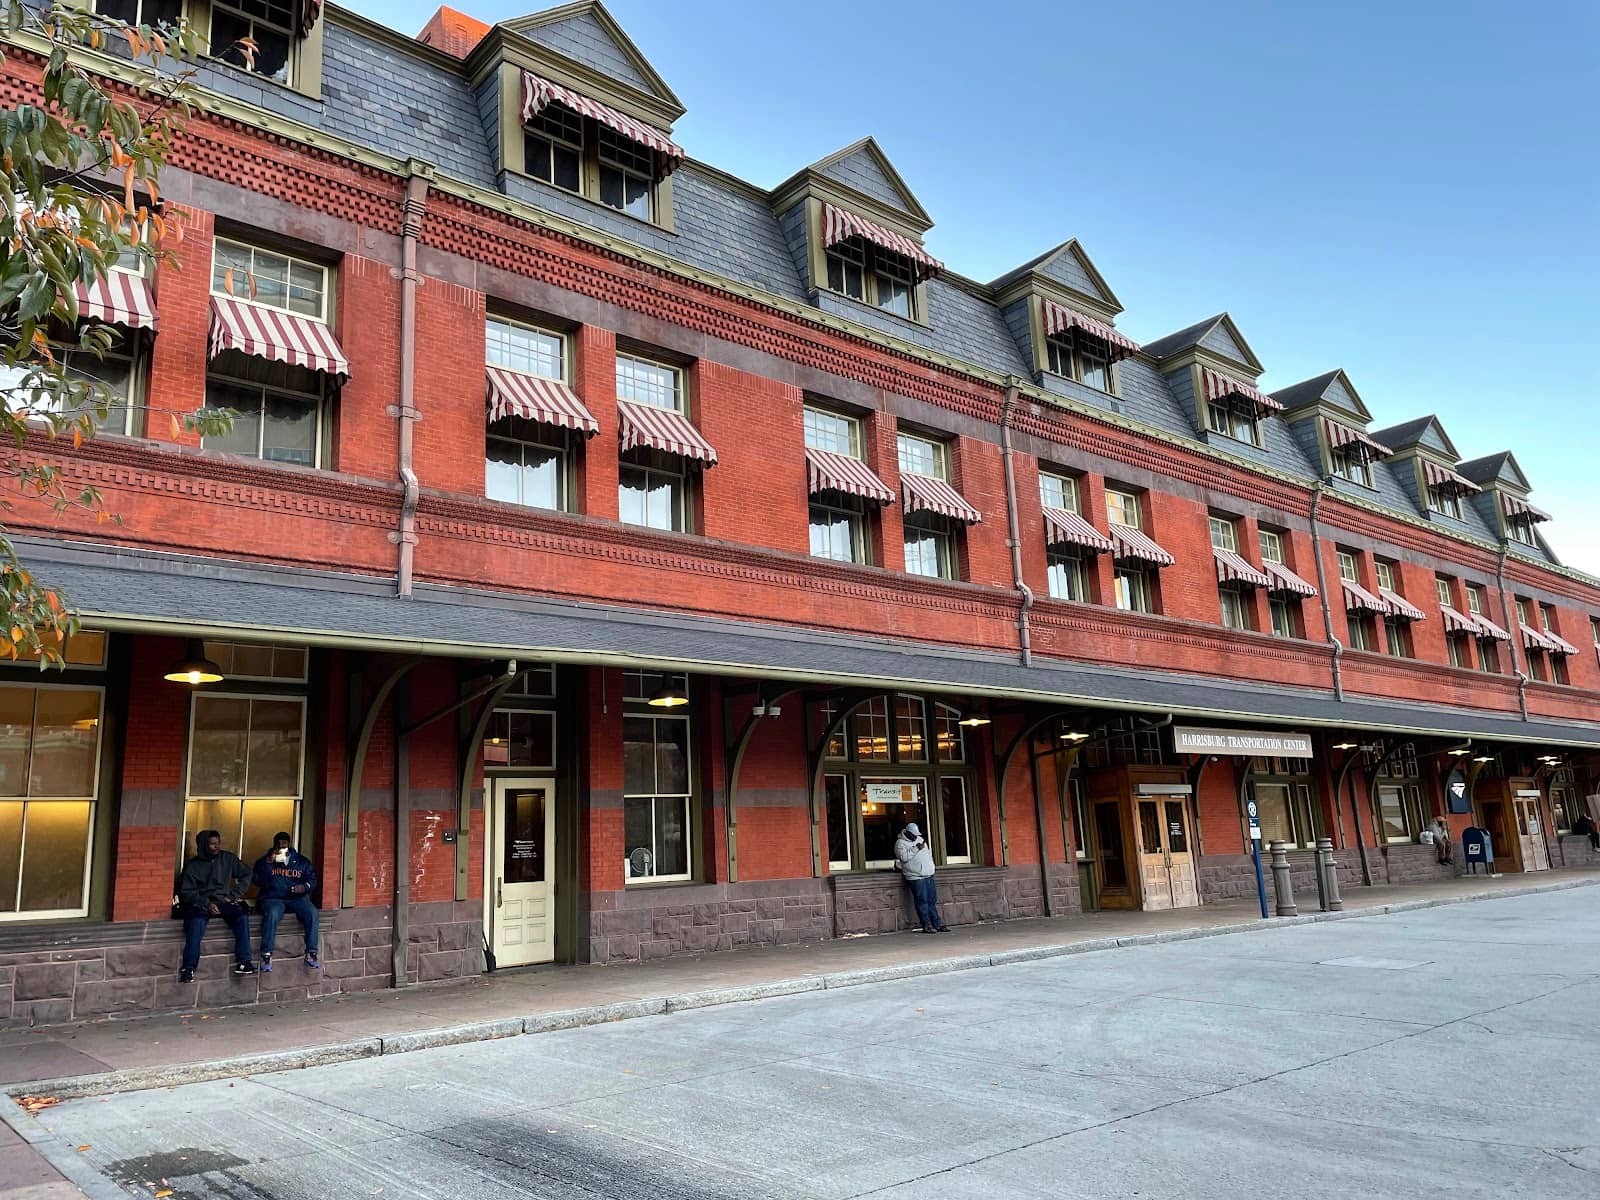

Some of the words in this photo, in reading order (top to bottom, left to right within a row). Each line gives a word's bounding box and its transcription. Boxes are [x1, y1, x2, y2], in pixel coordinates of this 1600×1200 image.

[1181, 733, 1225, 747] HARRISBURG
[1227, 736, 1282, 750] TRANSPORTATION
[1283, 739, 1306, 751] CENTER
